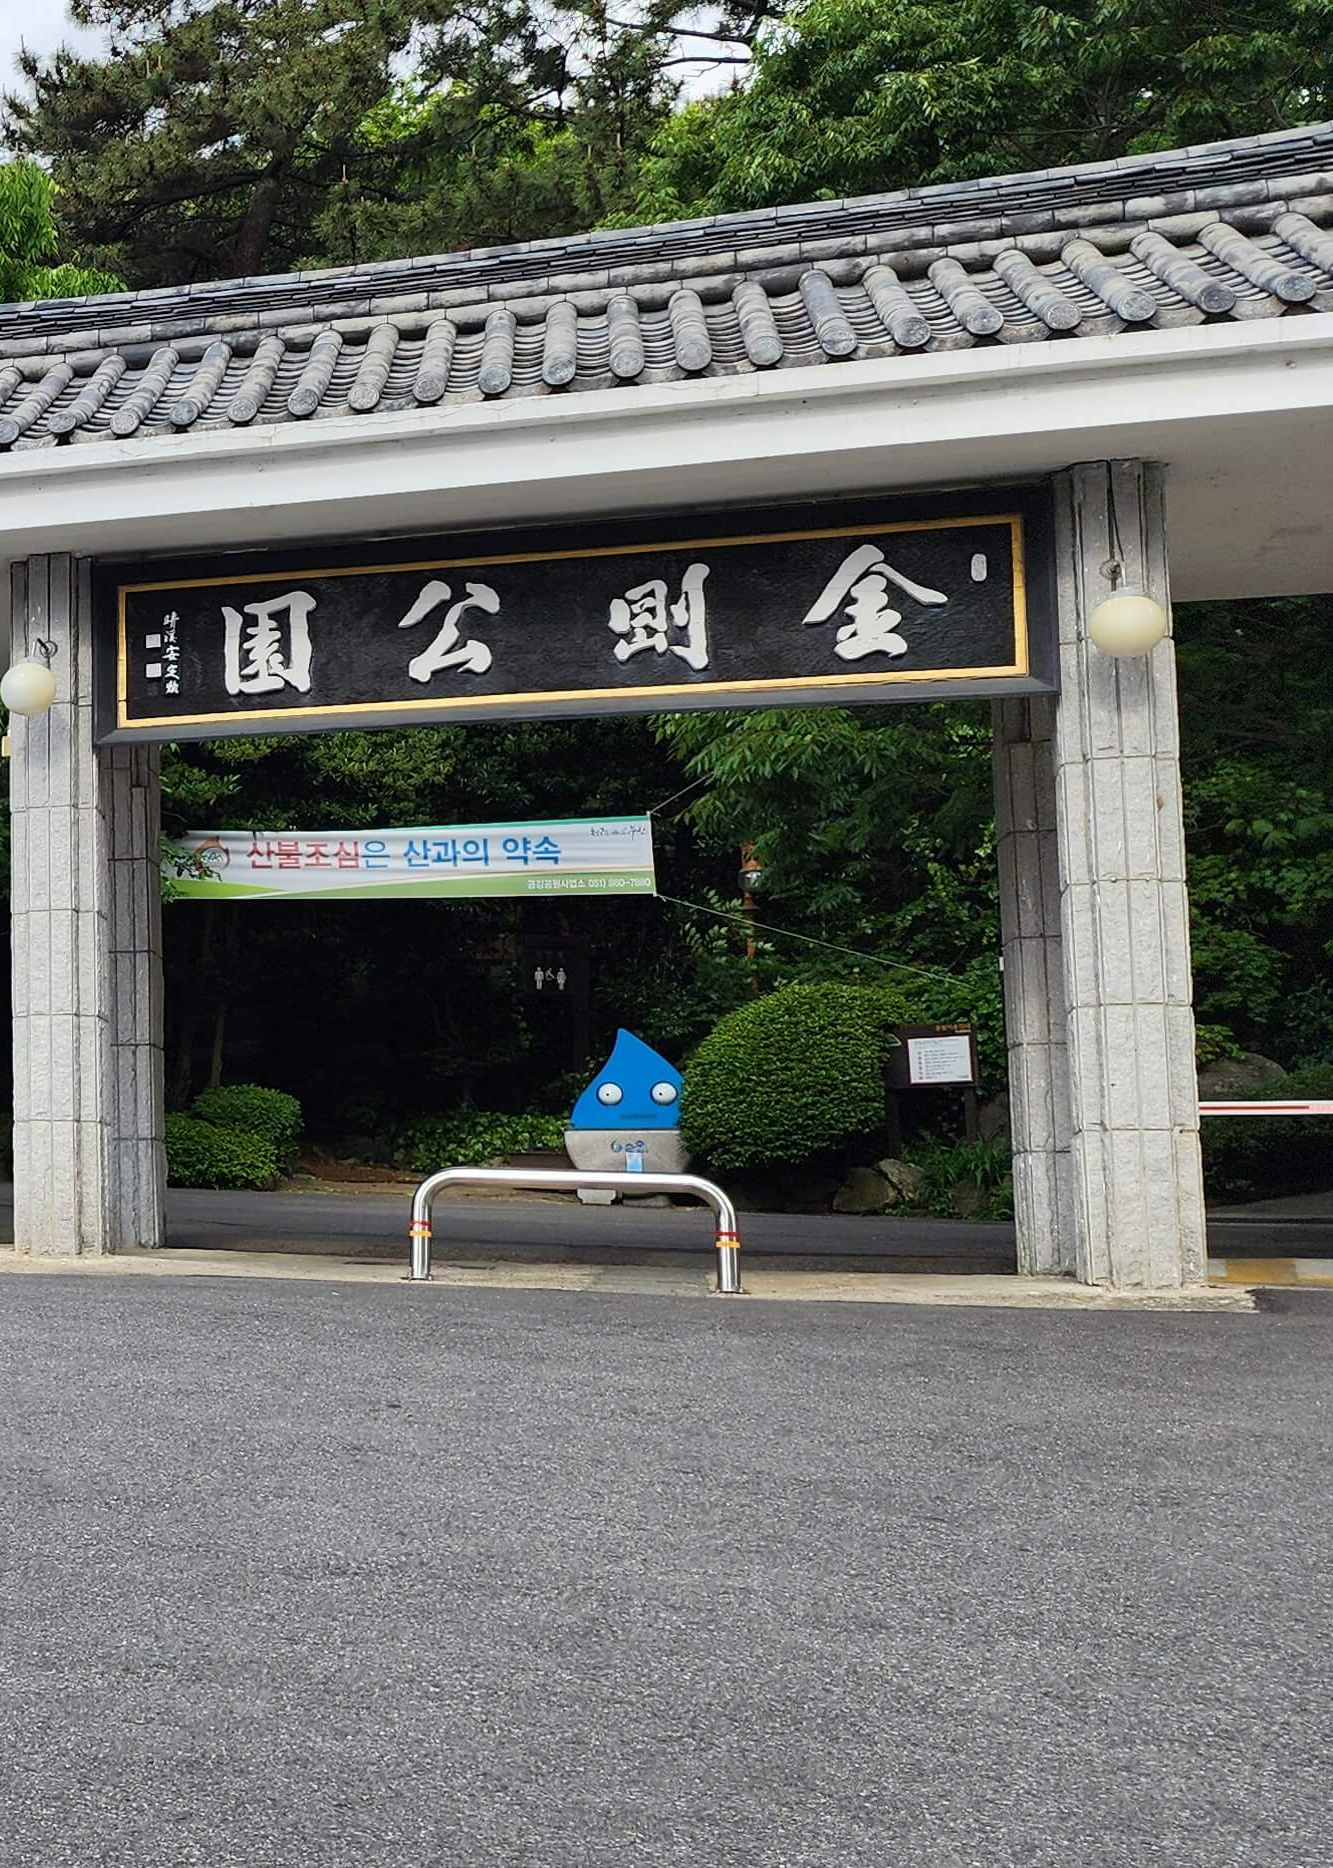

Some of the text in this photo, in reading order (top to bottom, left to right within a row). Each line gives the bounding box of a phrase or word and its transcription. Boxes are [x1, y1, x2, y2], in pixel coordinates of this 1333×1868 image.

[247, 836, 561, 869] 산불조심은 산과의 약속
